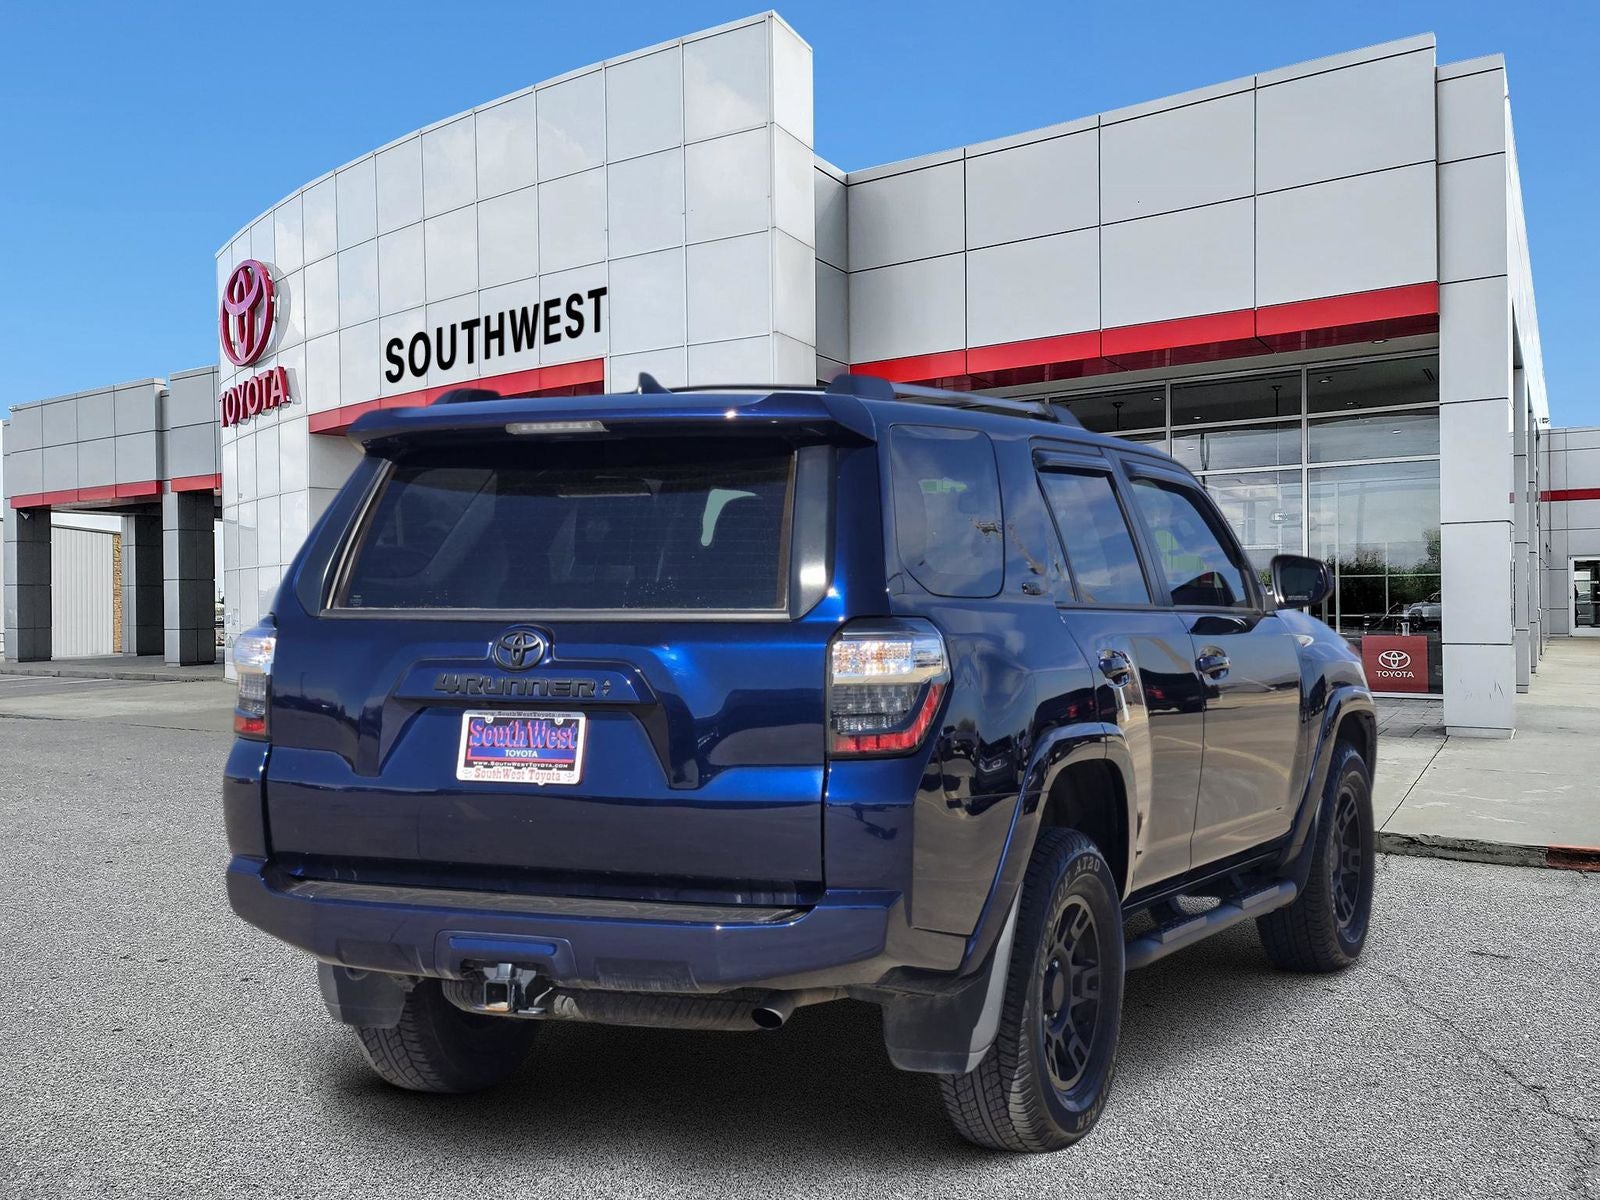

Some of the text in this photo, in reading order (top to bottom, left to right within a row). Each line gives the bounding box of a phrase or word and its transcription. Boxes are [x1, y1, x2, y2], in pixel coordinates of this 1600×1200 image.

[385, 287, 607, 383] SOUTHWEST
[218, 366, 291, 428] TOYOTA
[1376, 670, 1414, 678] TOYOTA
[433, 674, 595, 697] 4RUNNER
[505, 750, 538, 758] TOYOTA
[528, 770, 561, 782] Toyota
